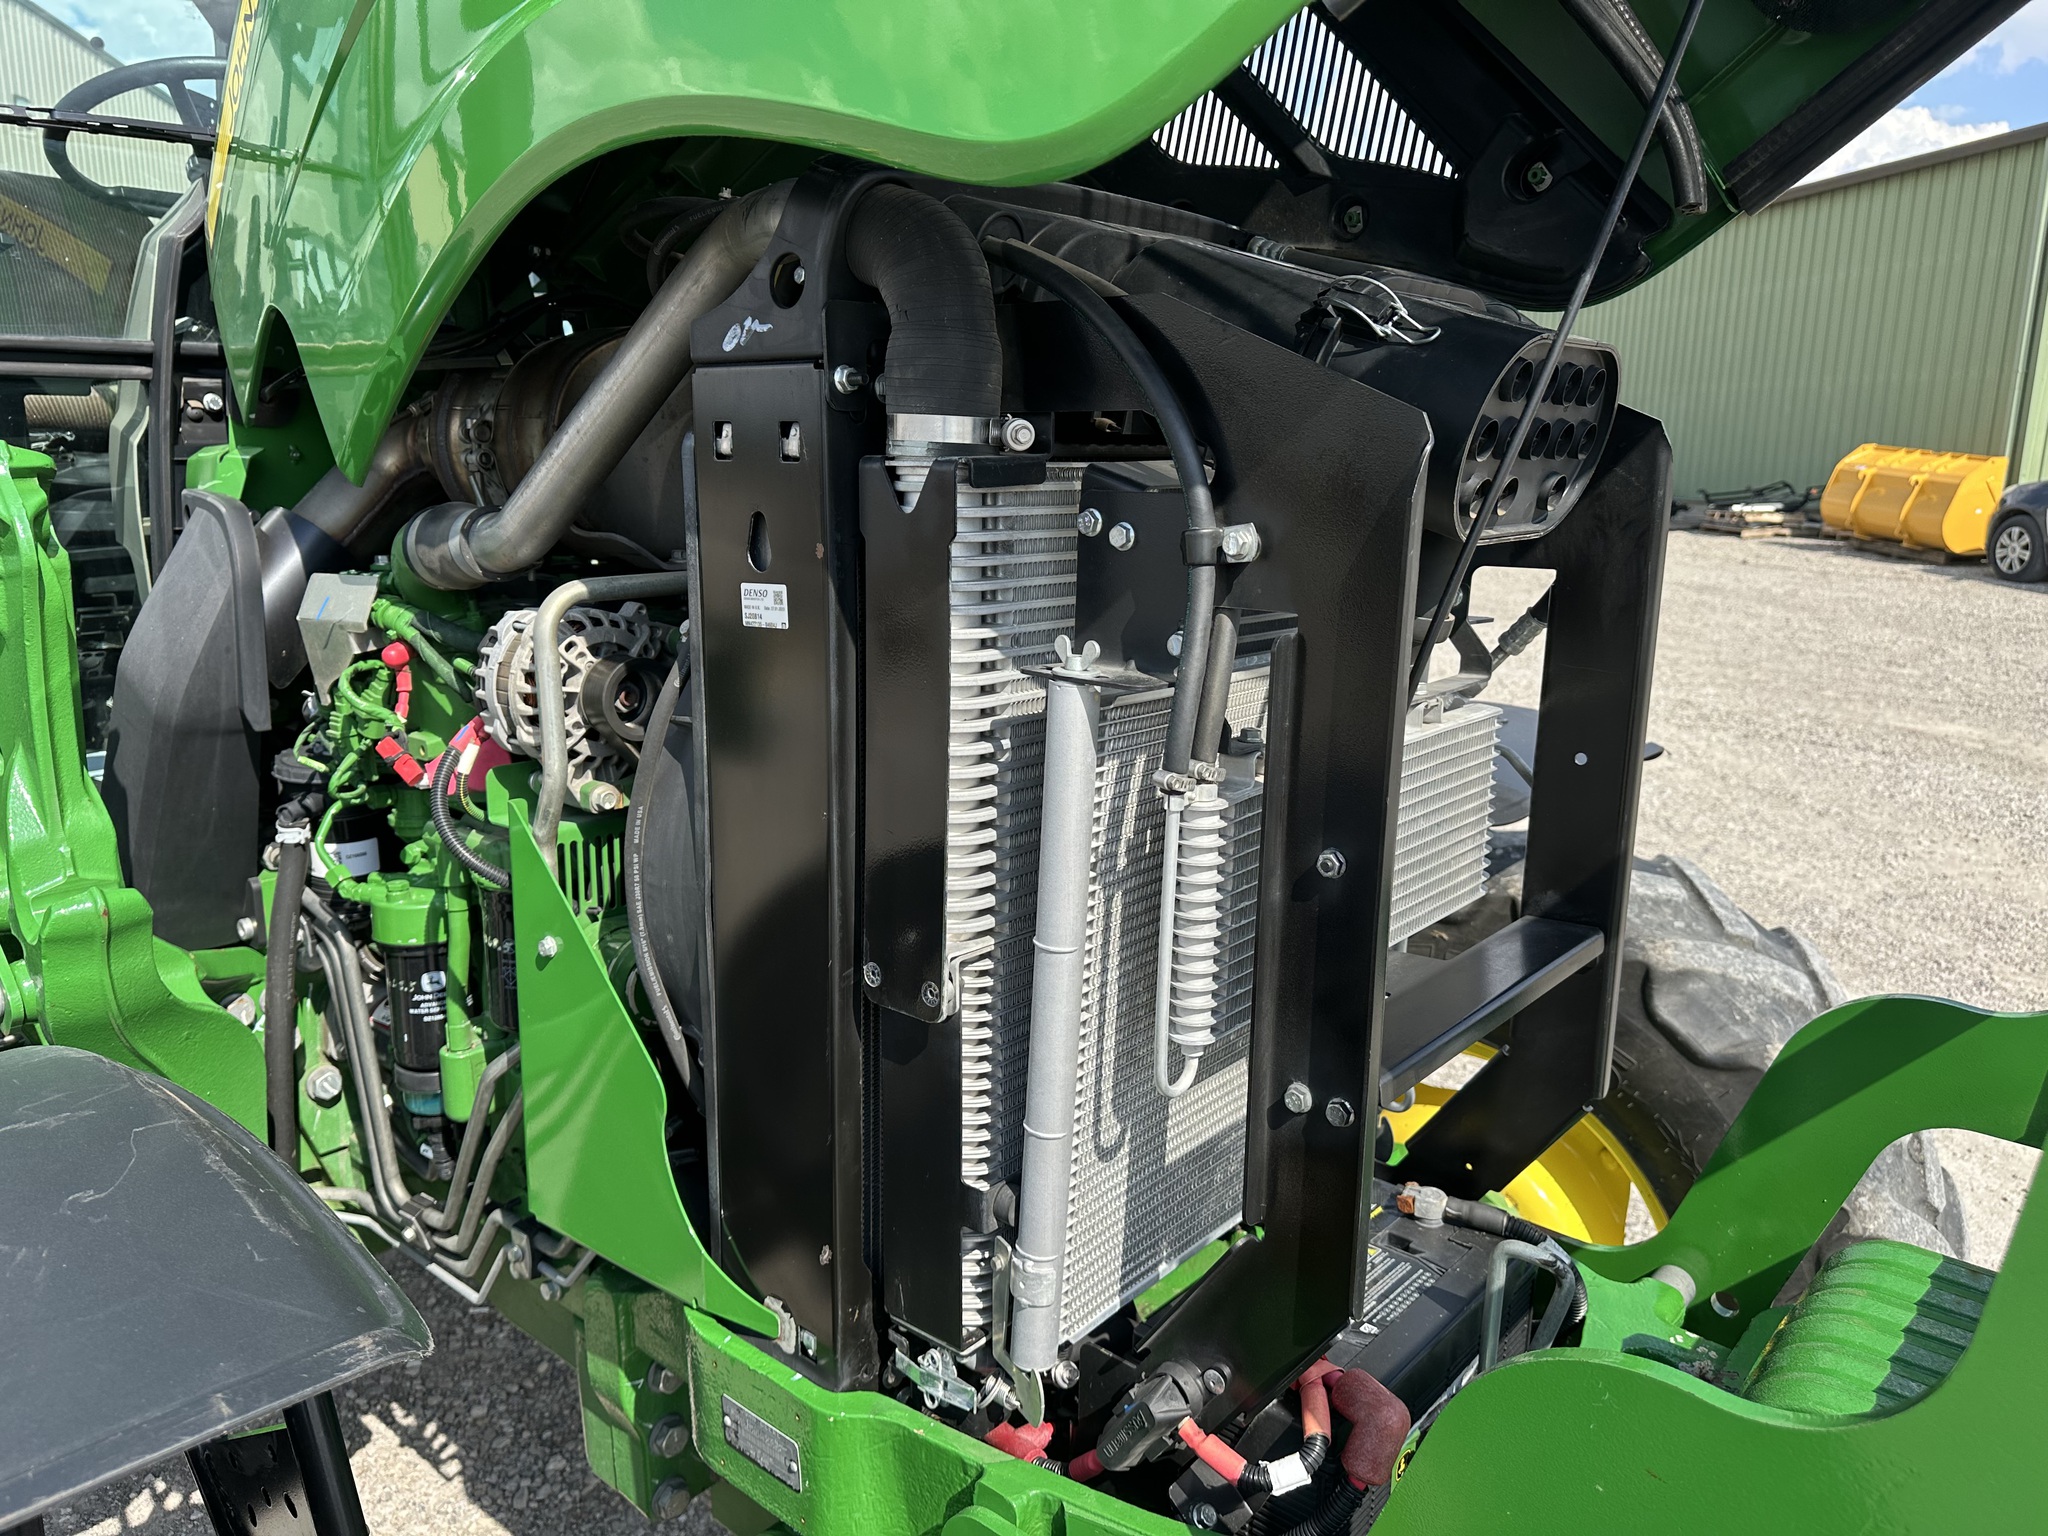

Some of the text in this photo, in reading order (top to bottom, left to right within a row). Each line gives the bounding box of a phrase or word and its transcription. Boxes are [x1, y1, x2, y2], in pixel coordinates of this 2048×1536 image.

[743, 588, 768, 598] DENSO
[636, 805, 644, 819] USA
[633, 826, 641, 844] MADE
[635, 901, 643, 914] SAE
[411, 993, 433, 1001] JOHN
